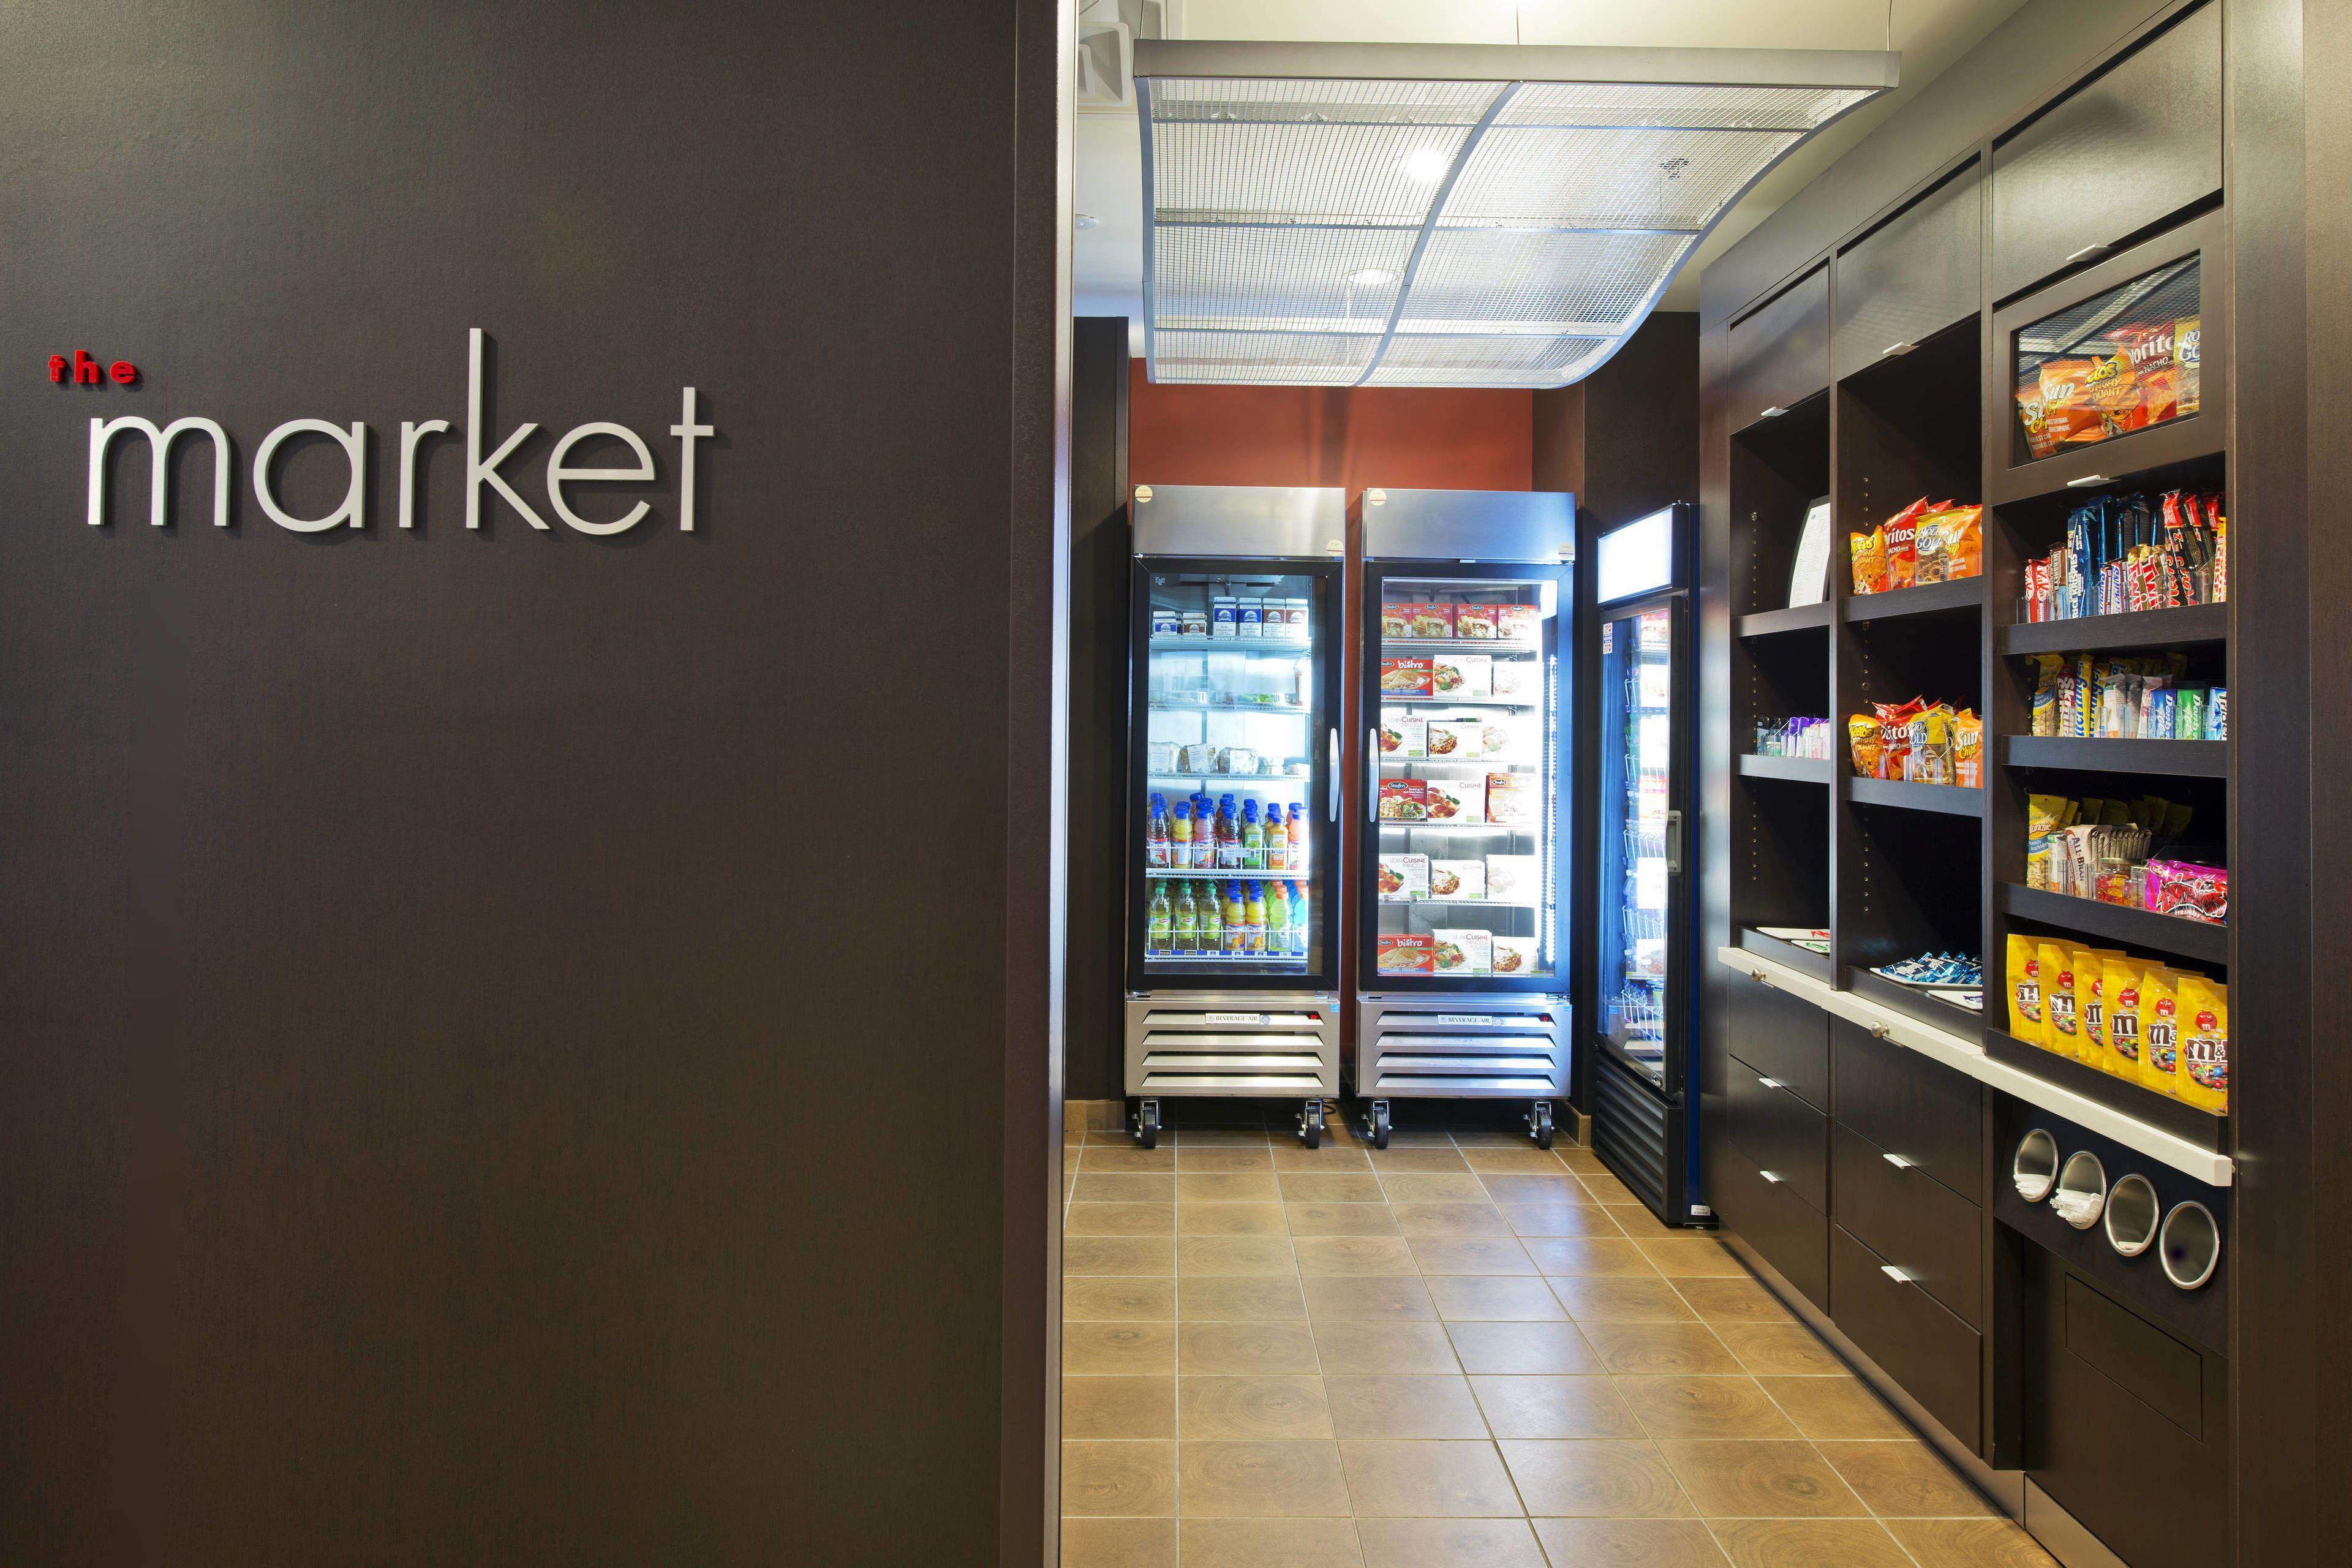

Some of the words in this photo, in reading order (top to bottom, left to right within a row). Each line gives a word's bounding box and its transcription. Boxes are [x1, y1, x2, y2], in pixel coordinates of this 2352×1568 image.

[49, 350, 137, 384] the
[2144, 356, 2169, 374] NACHO
[88, 328, 715, 535] market
[1887, 528, 1915, 545] ritos
[1398, 660, 1423, 668] bistro
[1955, 730, 1979, 751] Sun
[1396, 938, 1423, 947] bistro
